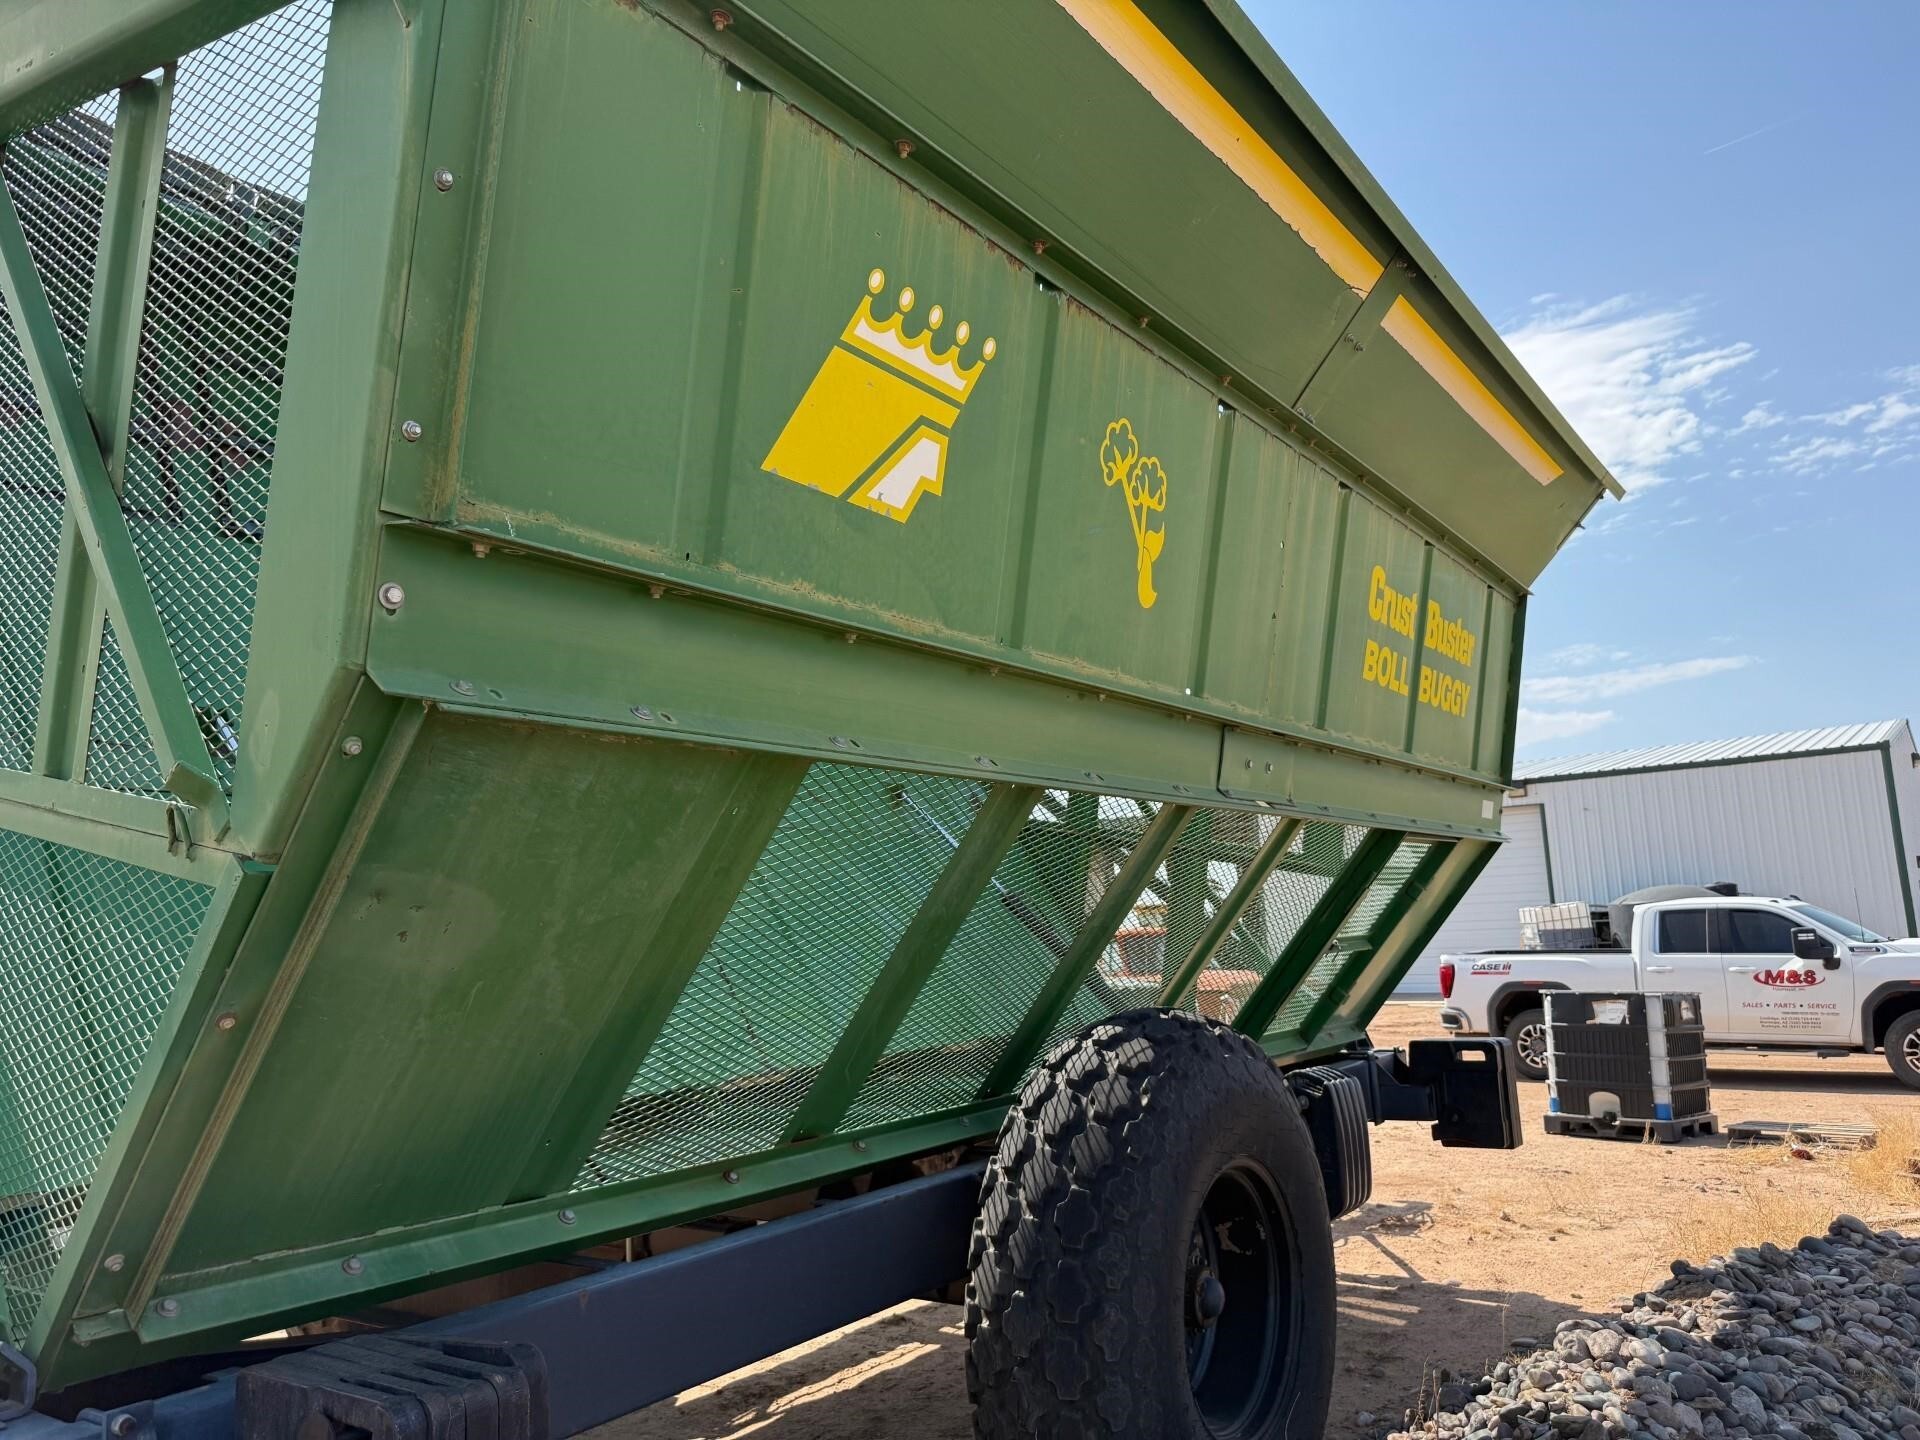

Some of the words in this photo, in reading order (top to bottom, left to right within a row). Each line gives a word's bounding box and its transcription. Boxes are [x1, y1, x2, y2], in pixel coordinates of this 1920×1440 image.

[1368, 565, 1418, 640] Crust
[1424, 599, 1476, 667] Buster
[1362, 639, 1409, 696] BOLL
[1418, 665, 1471, 718] BUGGY
[1764, 969, 1817, 985] M&S
